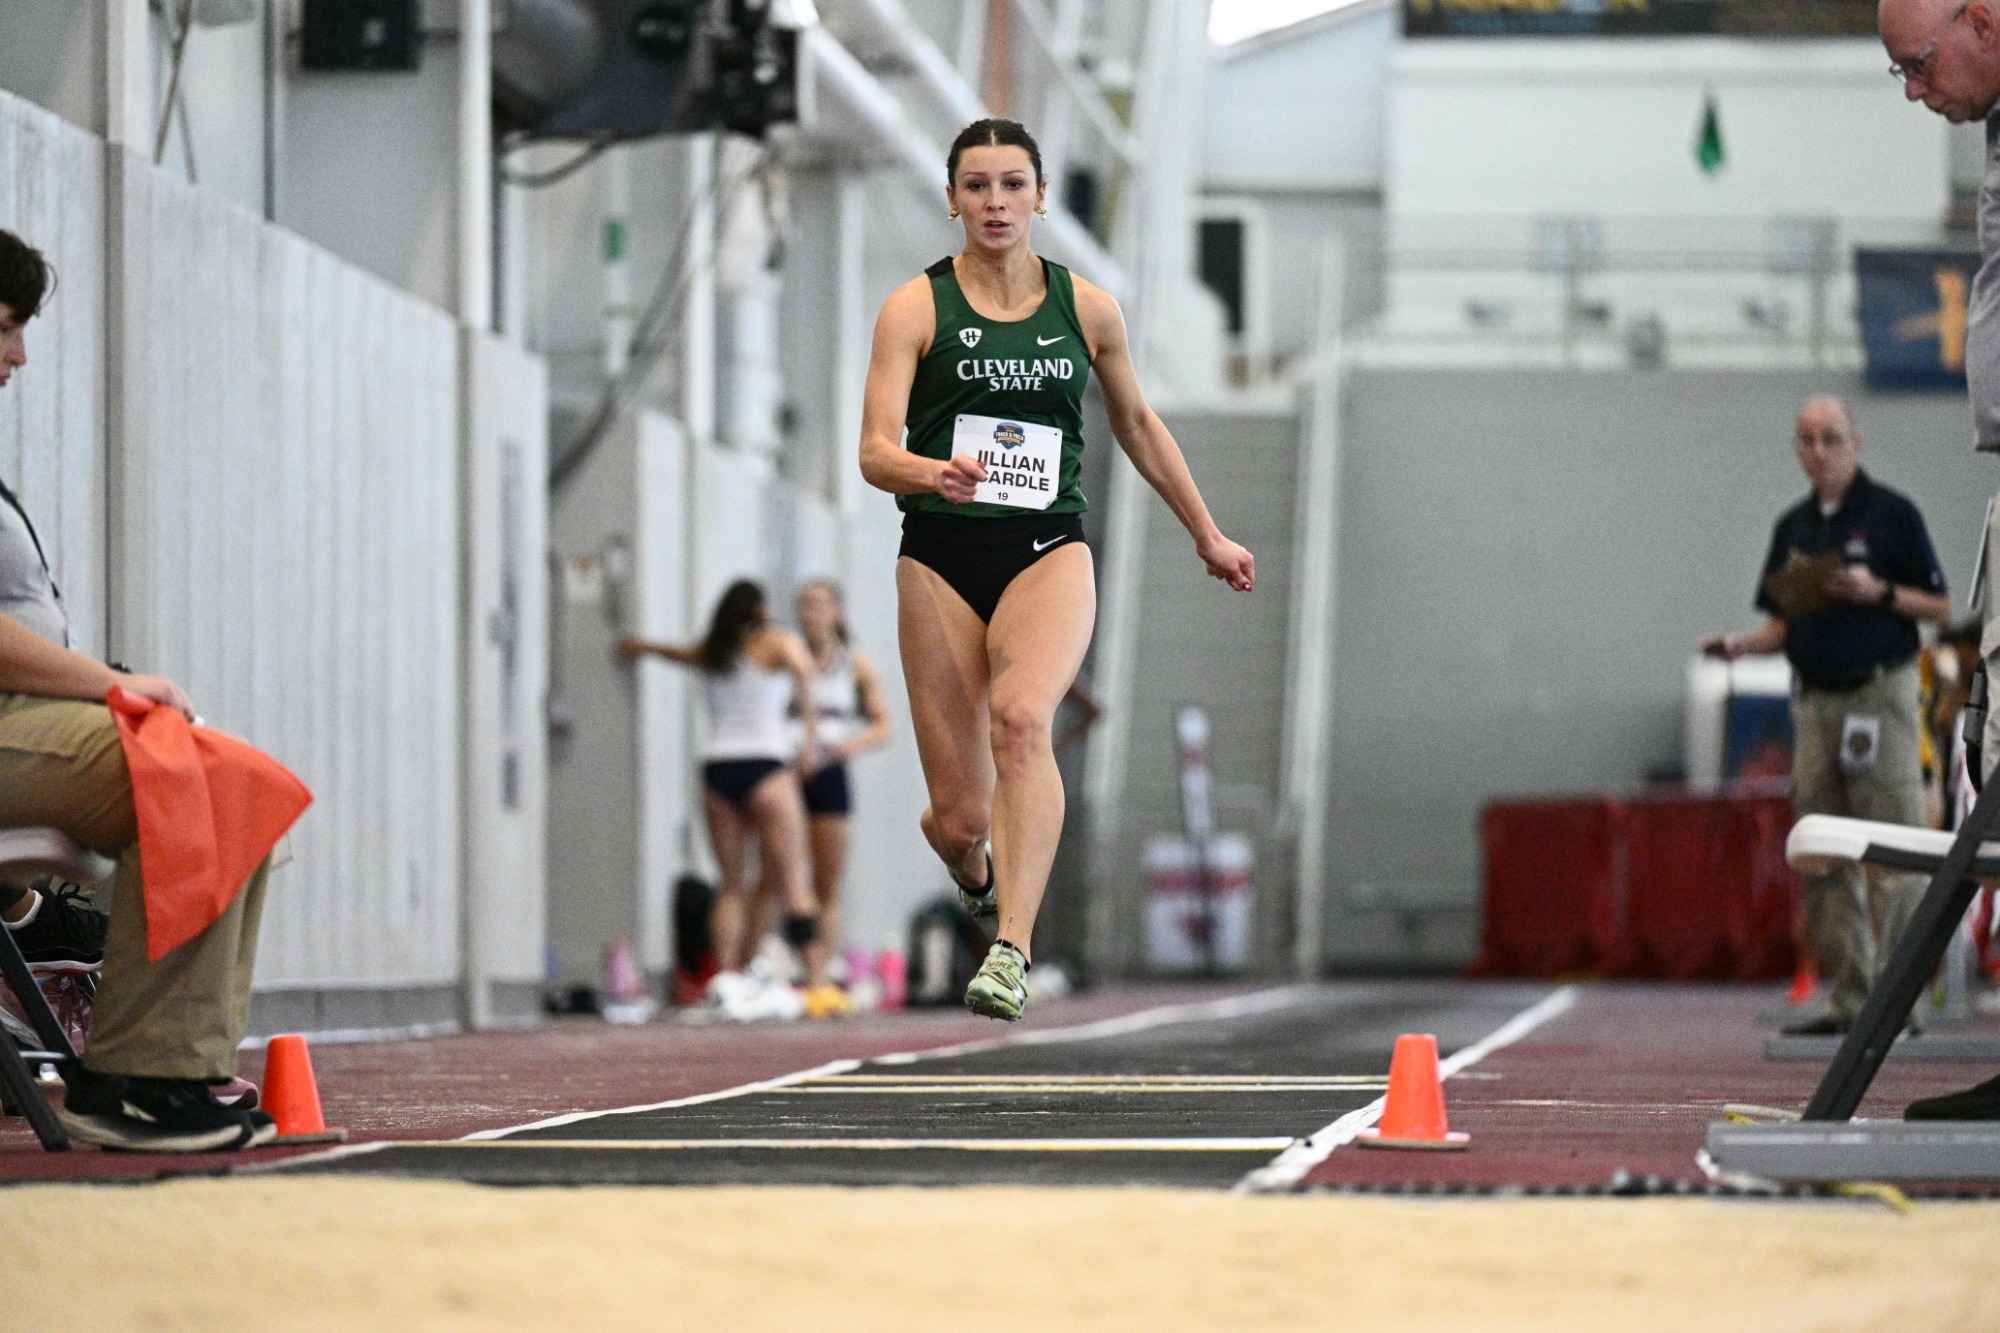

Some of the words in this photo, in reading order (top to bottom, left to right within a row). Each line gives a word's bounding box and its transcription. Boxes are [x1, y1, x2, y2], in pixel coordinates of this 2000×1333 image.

[956, 358, 1074, 381] CLEVELAND
[989, 376, 1043, 392] STATE
[997, 491, 1009, 501] 19
[986, 960, 1014, 970] NIKE
